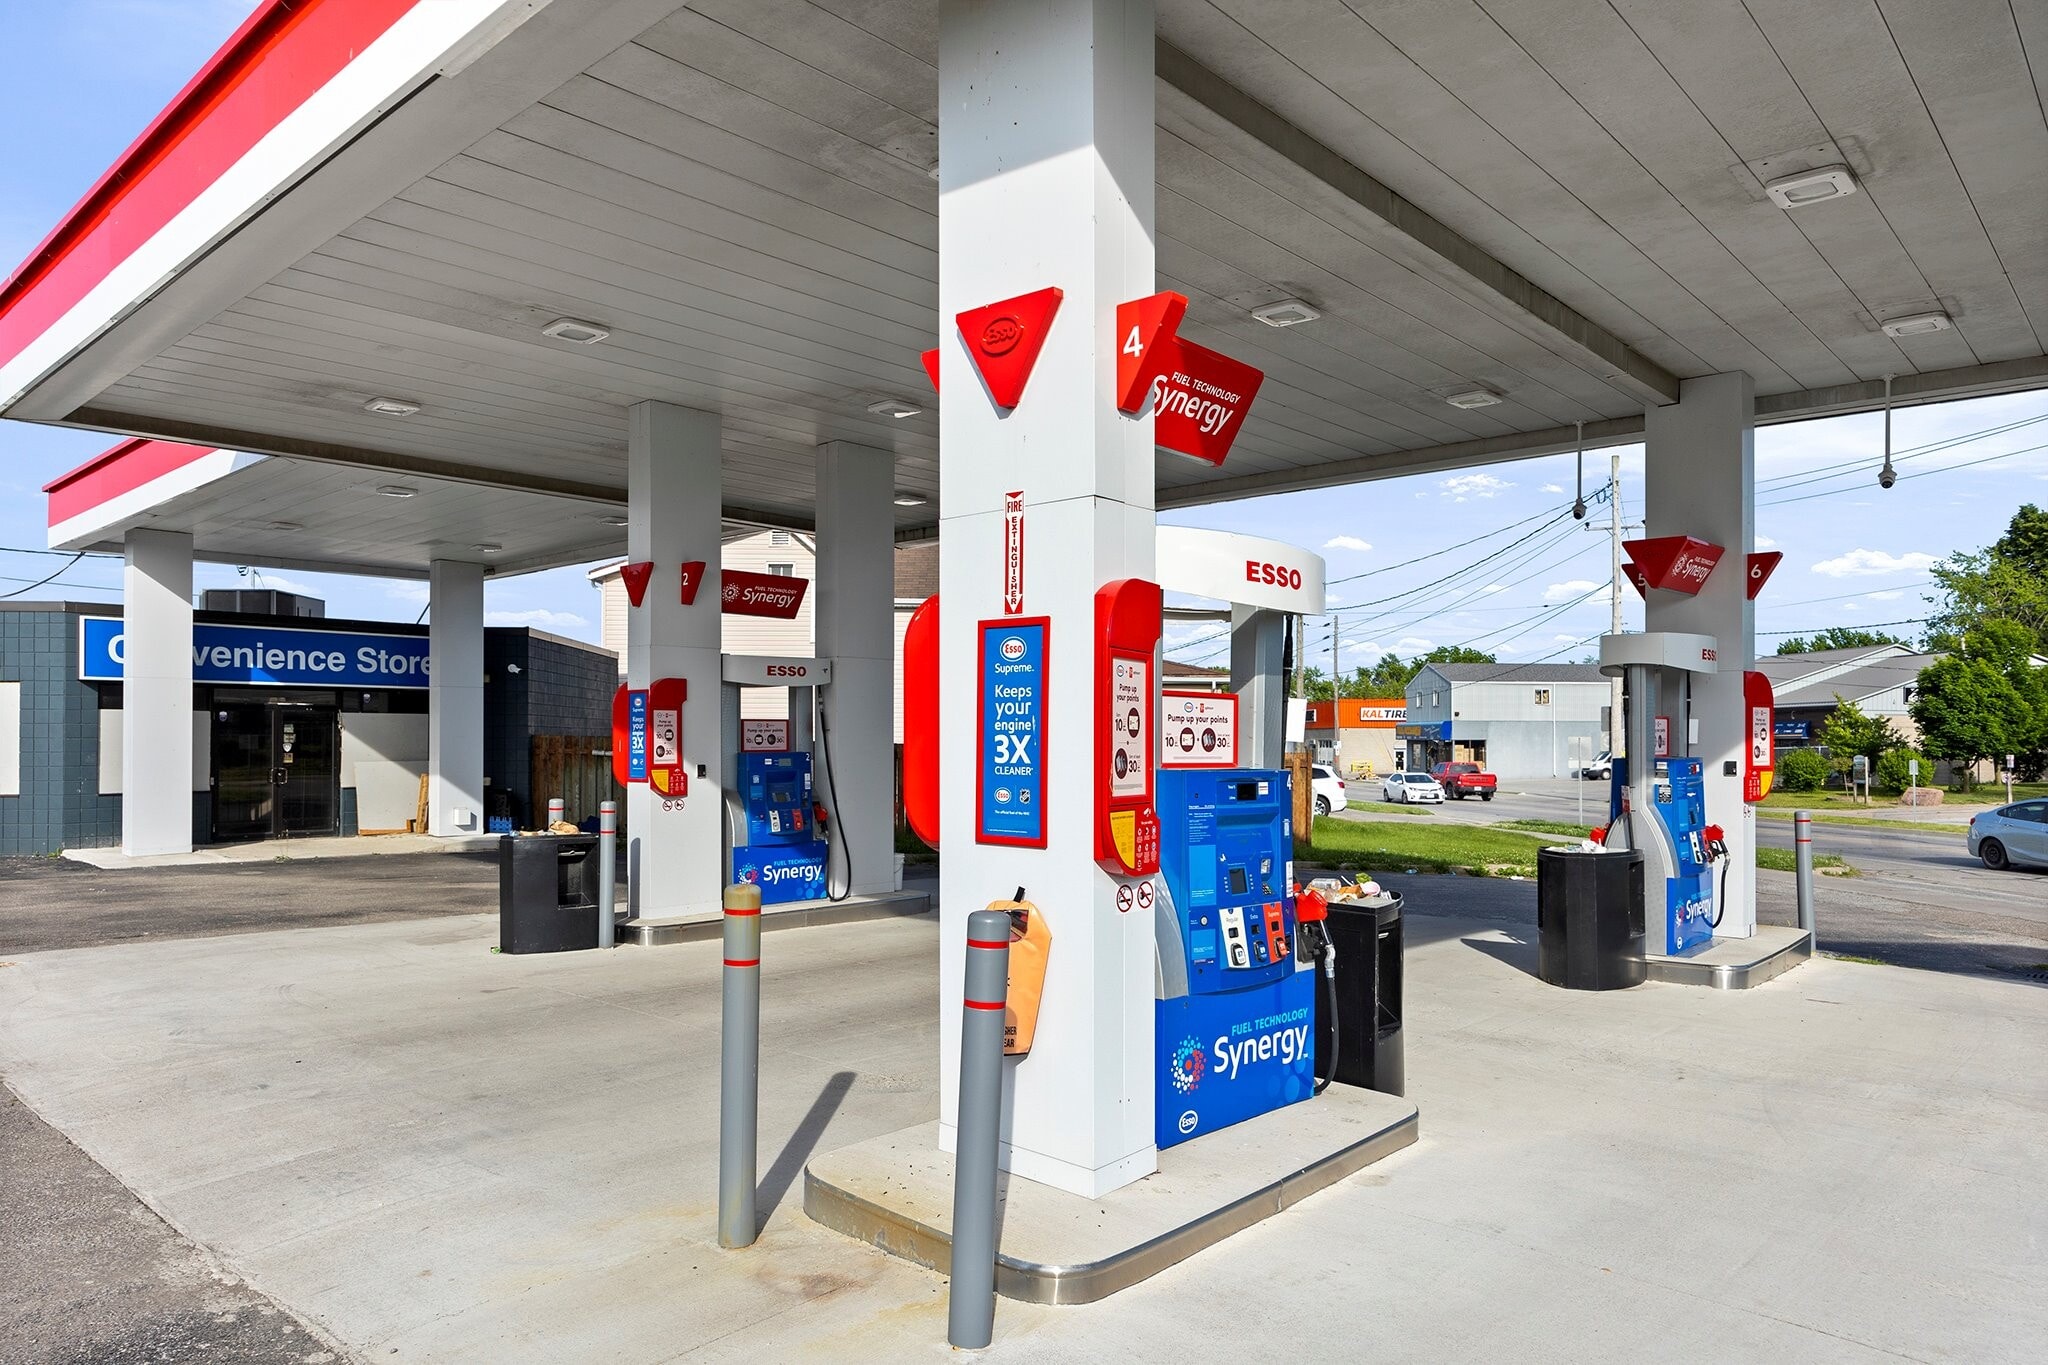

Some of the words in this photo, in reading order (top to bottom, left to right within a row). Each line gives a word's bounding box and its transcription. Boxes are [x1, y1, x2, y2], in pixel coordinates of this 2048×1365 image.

[1123, 325, 1143, 357] 4
[1172, 371, 1190, 386] FUEL
[1193, 379, 1240, 404] TECHNOLOGY
[1154, 375, 1233, 435] Synergy
[1007, 500, 1022, 513] FIRE
[1246, 560, 1302, 590] ESSO
[1682, 559, 1711, 583] Synergy
[1751, 564, 1761, 578] 6
[682, 573, 688, 586] 2
[742, 588, 796, 608] Synergy
[108, 634, 346, 671] Cvenience
[1005, 644, 1022, 654] Esso
[1702, 648, 1716, 662] ESS
[767, 666, 806, 677] ESSO
[995, 685, 1032, 701] Keeps
[995, 702, 1032, 720] your
[995, 718, 1031, 734] engine
[1168, 714, 1185, 724] Pump
[1195, 717, 1208, 725] your
[1210, 716, 1228, 725] points
[632, 738, 644, 750] 3X
[994, 734, 1032, 764] 3X
[1166, 736, 1174, 747] 10
[1217, 738, 1226, 748] 30
[1286, 774, 1292, 790] 4
[788, 857, 822, 865] TECHNOLOGY
[764, 865, 822, 884] Synergy
[1686, 898, 1712, 924] Synergy
[1232, 1024, 1252, 1036] FUEL
[1254, 1008, 1308, 1031] TECHNOLOGY
[1214, 1024, 1308, 1080] Synergy
[1182, 1116, 1196, 1127] Esso
